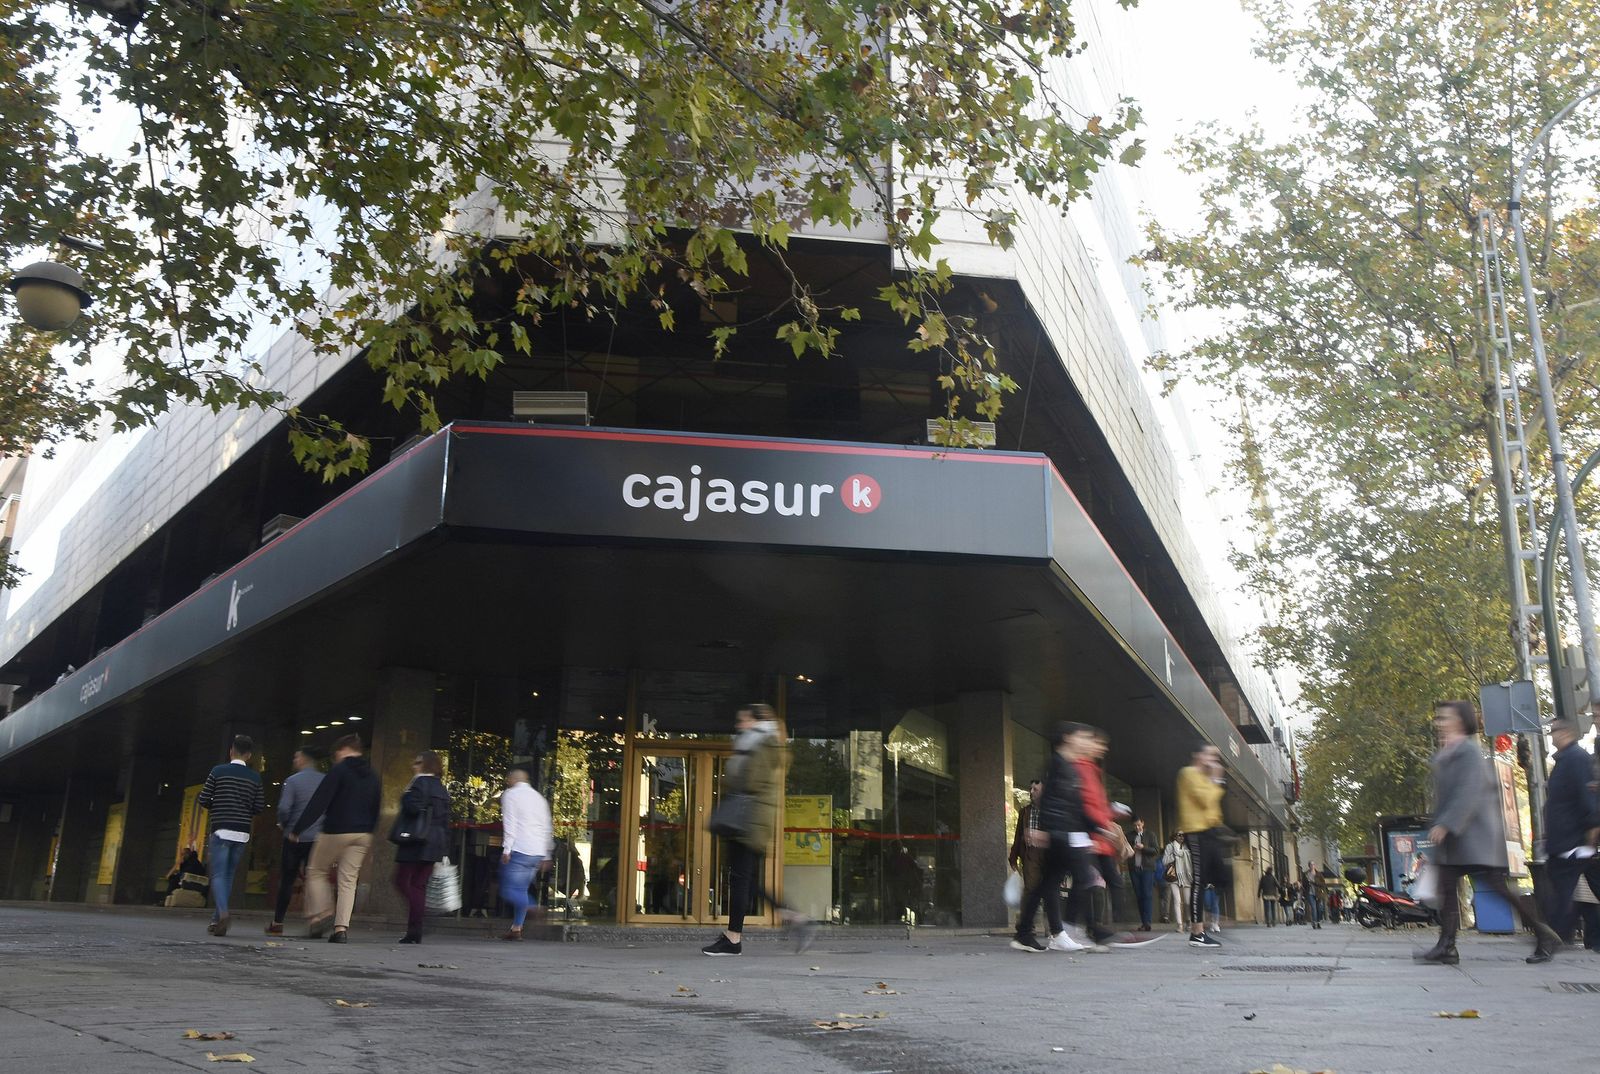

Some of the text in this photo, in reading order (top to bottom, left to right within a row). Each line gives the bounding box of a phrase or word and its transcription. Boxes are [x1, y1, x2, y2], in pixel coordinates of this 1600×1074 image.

[622, 464, 872, 522] cajasur k
[642, 713, 658, 735] k
